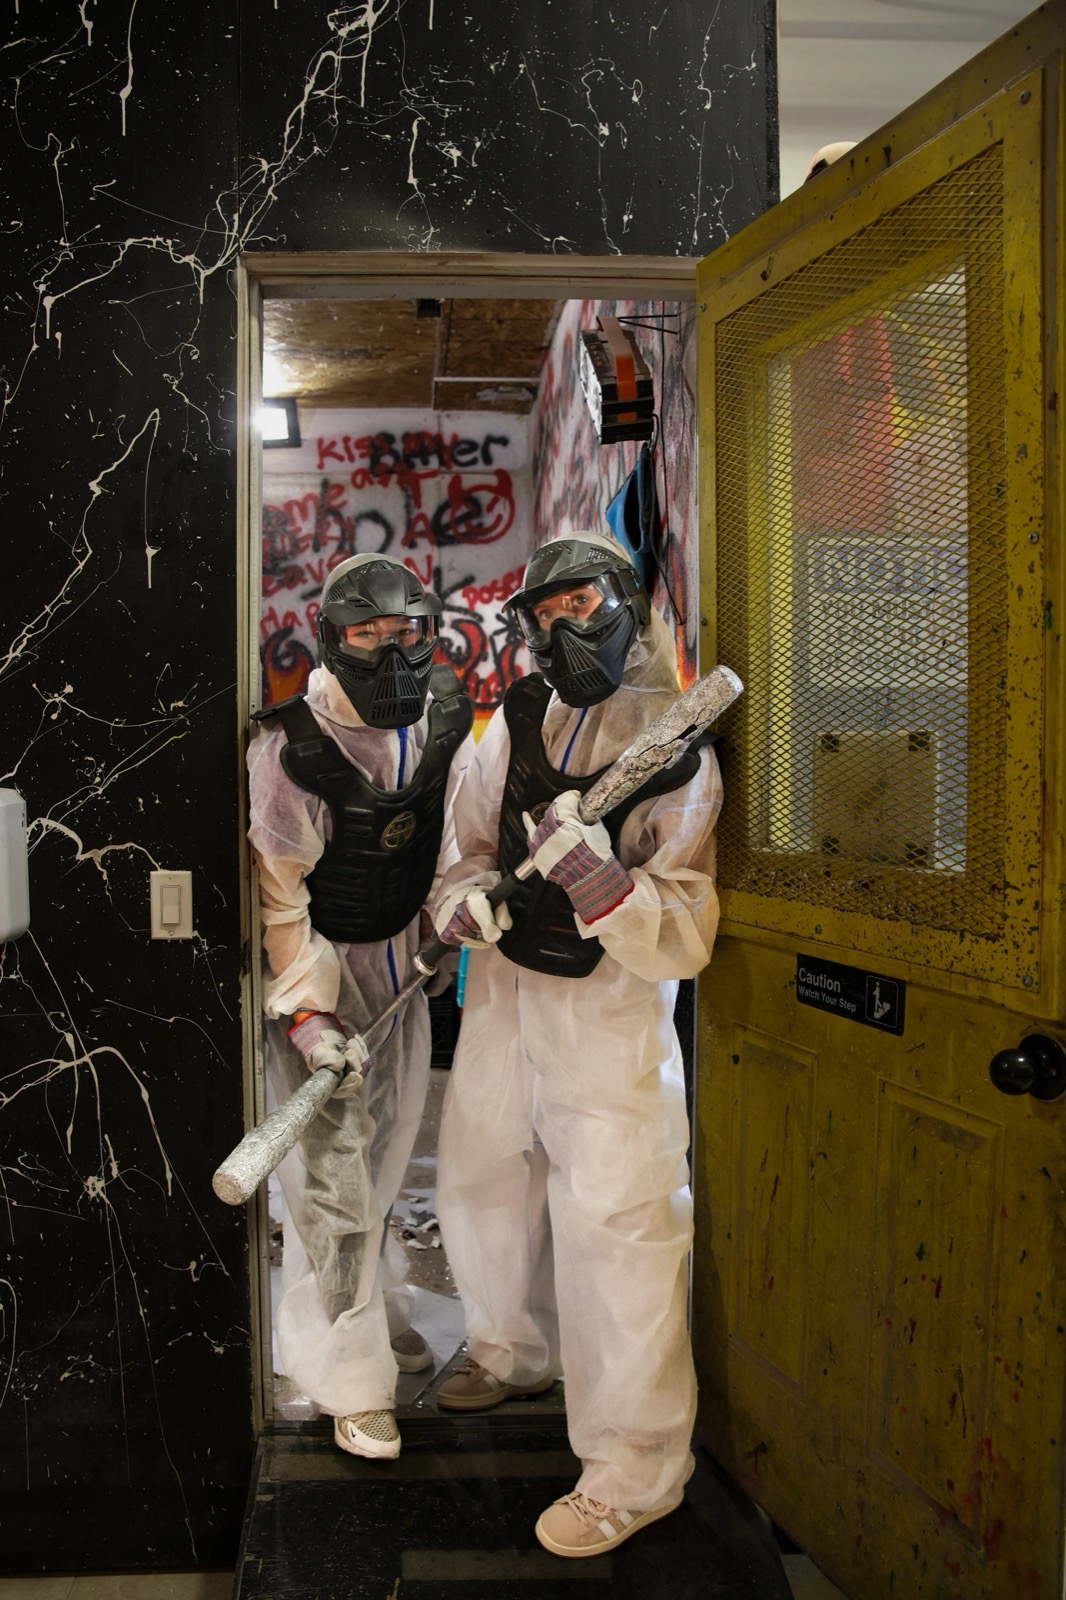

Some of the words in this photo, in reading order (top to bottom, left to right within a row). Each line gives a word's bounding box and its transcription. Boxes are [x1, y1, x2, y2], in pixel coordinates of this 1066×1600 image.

[798, 967, 841, 993] Caution
[798, 985, 820, 1000] Watch
[820, 992, 838, 1006] Your
[838, 998, 857, 1014] Step
